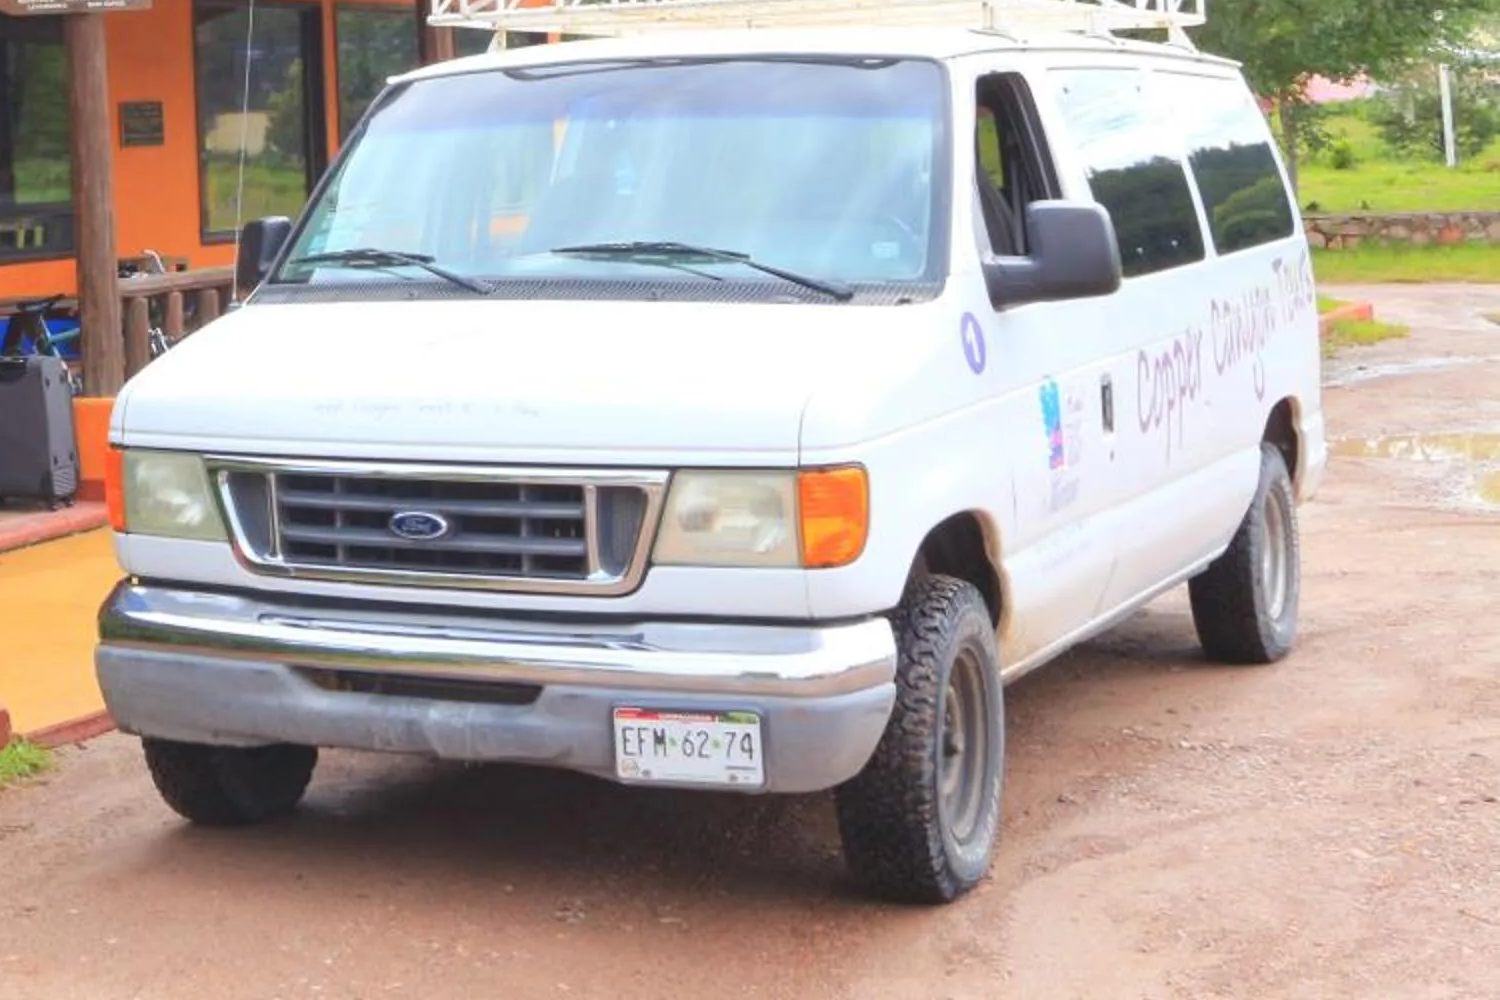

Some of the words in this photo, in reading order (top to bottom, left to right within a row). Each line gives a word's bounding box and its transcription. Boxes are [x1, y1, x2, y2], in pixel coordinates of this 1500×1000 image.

[1137, 326, 1203, 465] Copper
[622, 727, 667, 757] EFM
[682, 730, 710, 759] 62
